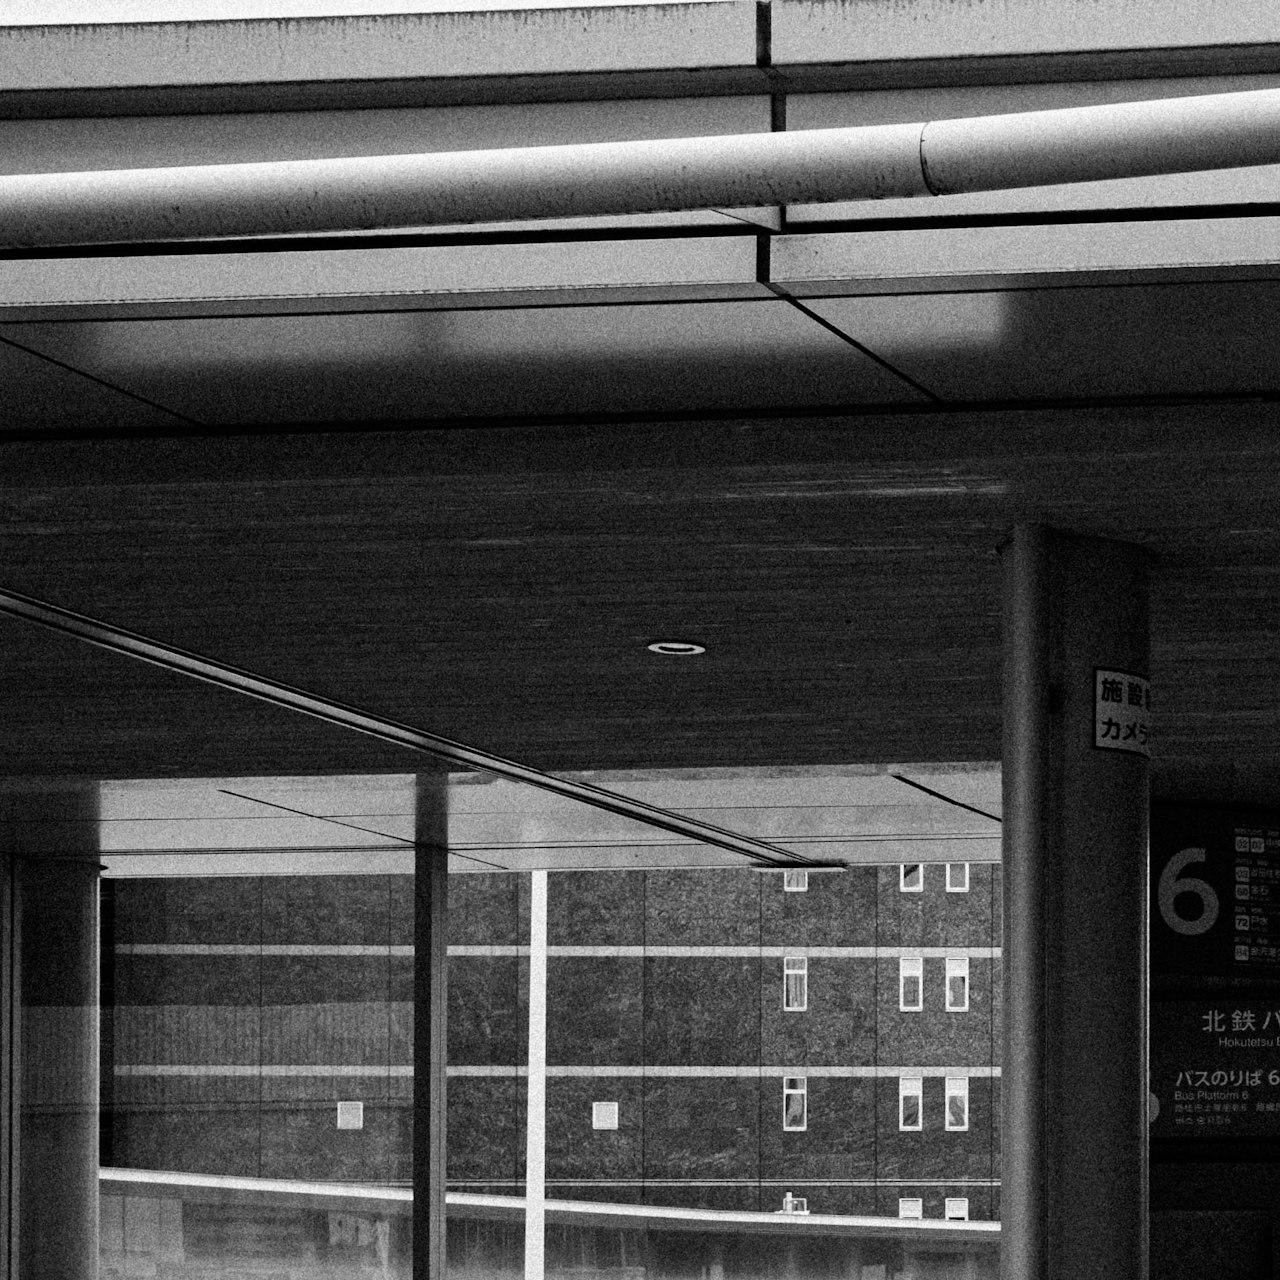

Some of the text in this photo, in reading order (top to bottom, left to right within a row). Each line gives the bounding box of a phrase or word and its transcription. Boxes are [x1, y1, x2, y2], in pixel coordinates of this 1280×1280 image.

[1101, 678, 1150, 712] 施設
[1157, 846, 1220, 937] 6
[1237, 917, 1249, 928] 72
[1218, 1037, 1274, 1047] Hokutetsu
[1175, 1069, 1280, 1087] バスのりば 6
[1174, 1090, 1249, 1101] Bus Platform 6
